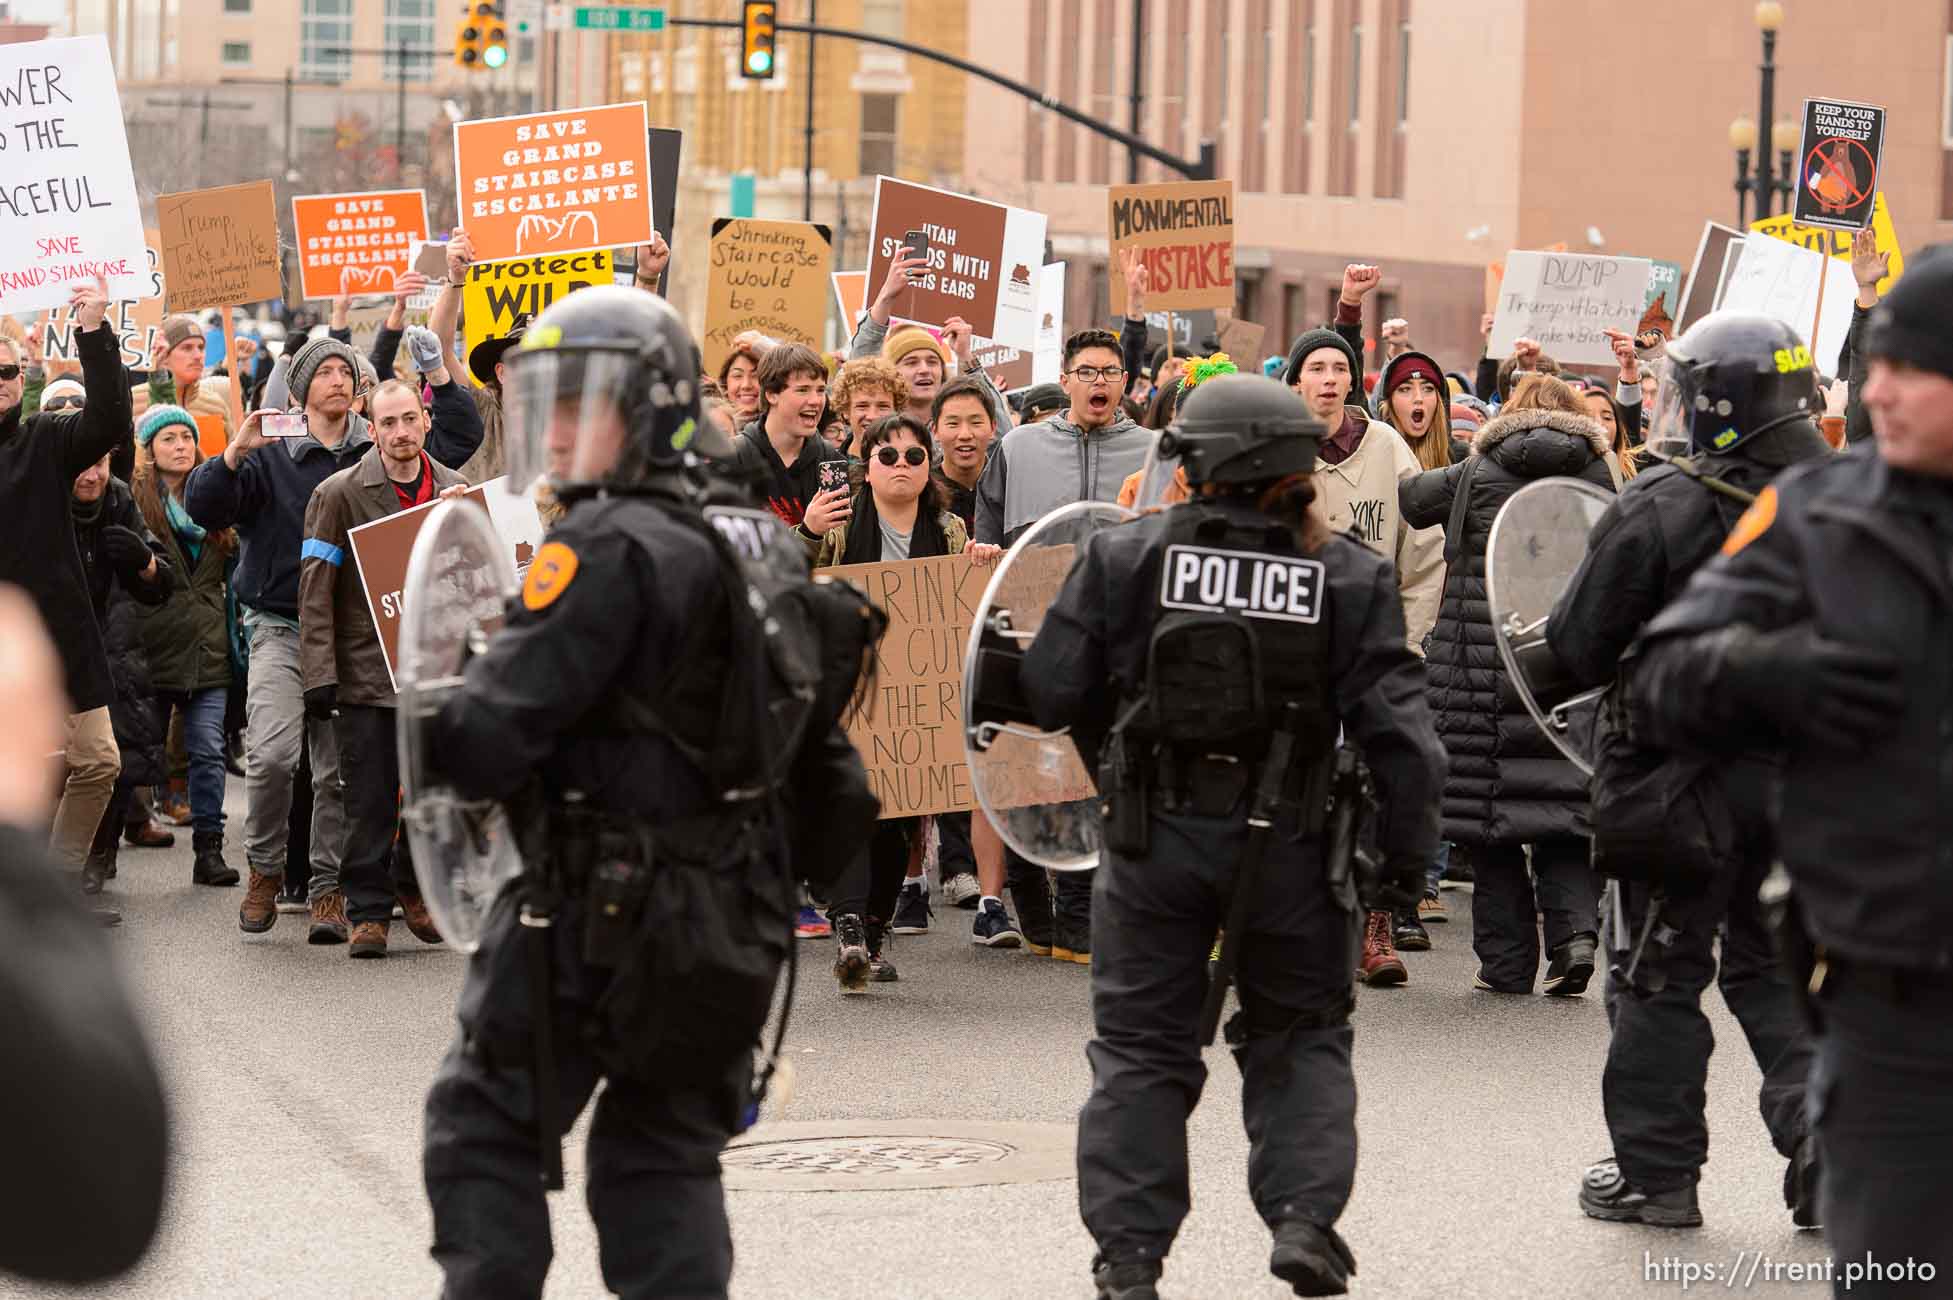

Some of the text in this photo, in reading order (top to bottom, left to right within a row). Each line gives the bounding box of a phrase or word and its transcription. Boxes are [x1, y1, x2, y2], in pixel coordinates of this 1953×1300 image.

[1815, 104, 1876, 121] KEEP YOUR
[1815, 115, 1873, 131] HANDS TO
[15, 118, 79, 152] THE
[516, 119, 587, 142] SAVE
[1815, 126, 1872, 141] YOURSELF
[502, 140, 603, 167] GRAND
[473, 159, 635, 193] STAIRCASE
[334, 199, 385, 214] SAVE
[472, 183, 639, 217] ESCALANTE
[326, 215, 397, 232] GRAND
[1112, 196, 1233, 240] MONUMENTAL
[36, 236, 83, 260] SAVE
[731, 219, 806, 255] Shrinking
[307, 248, 410, 267] ESCALANT
[472, 252, 606, 282] Protect
[711, 241, 819, 268] Staircase
[881, 237, 991, 281] STDS WITH
[0, 267, 46, 298] RAND
[1542, 256, 1618, 287] DUMP
[729, 289, 788, 312] be a
[940, 276, 977, 300] EARS
[1173, 552, 1313, 615] POLICE
[907, 627, 962, 676] CUT
[881, 683, 928, 729] THE
[872, 726, 942, 765] NOT
